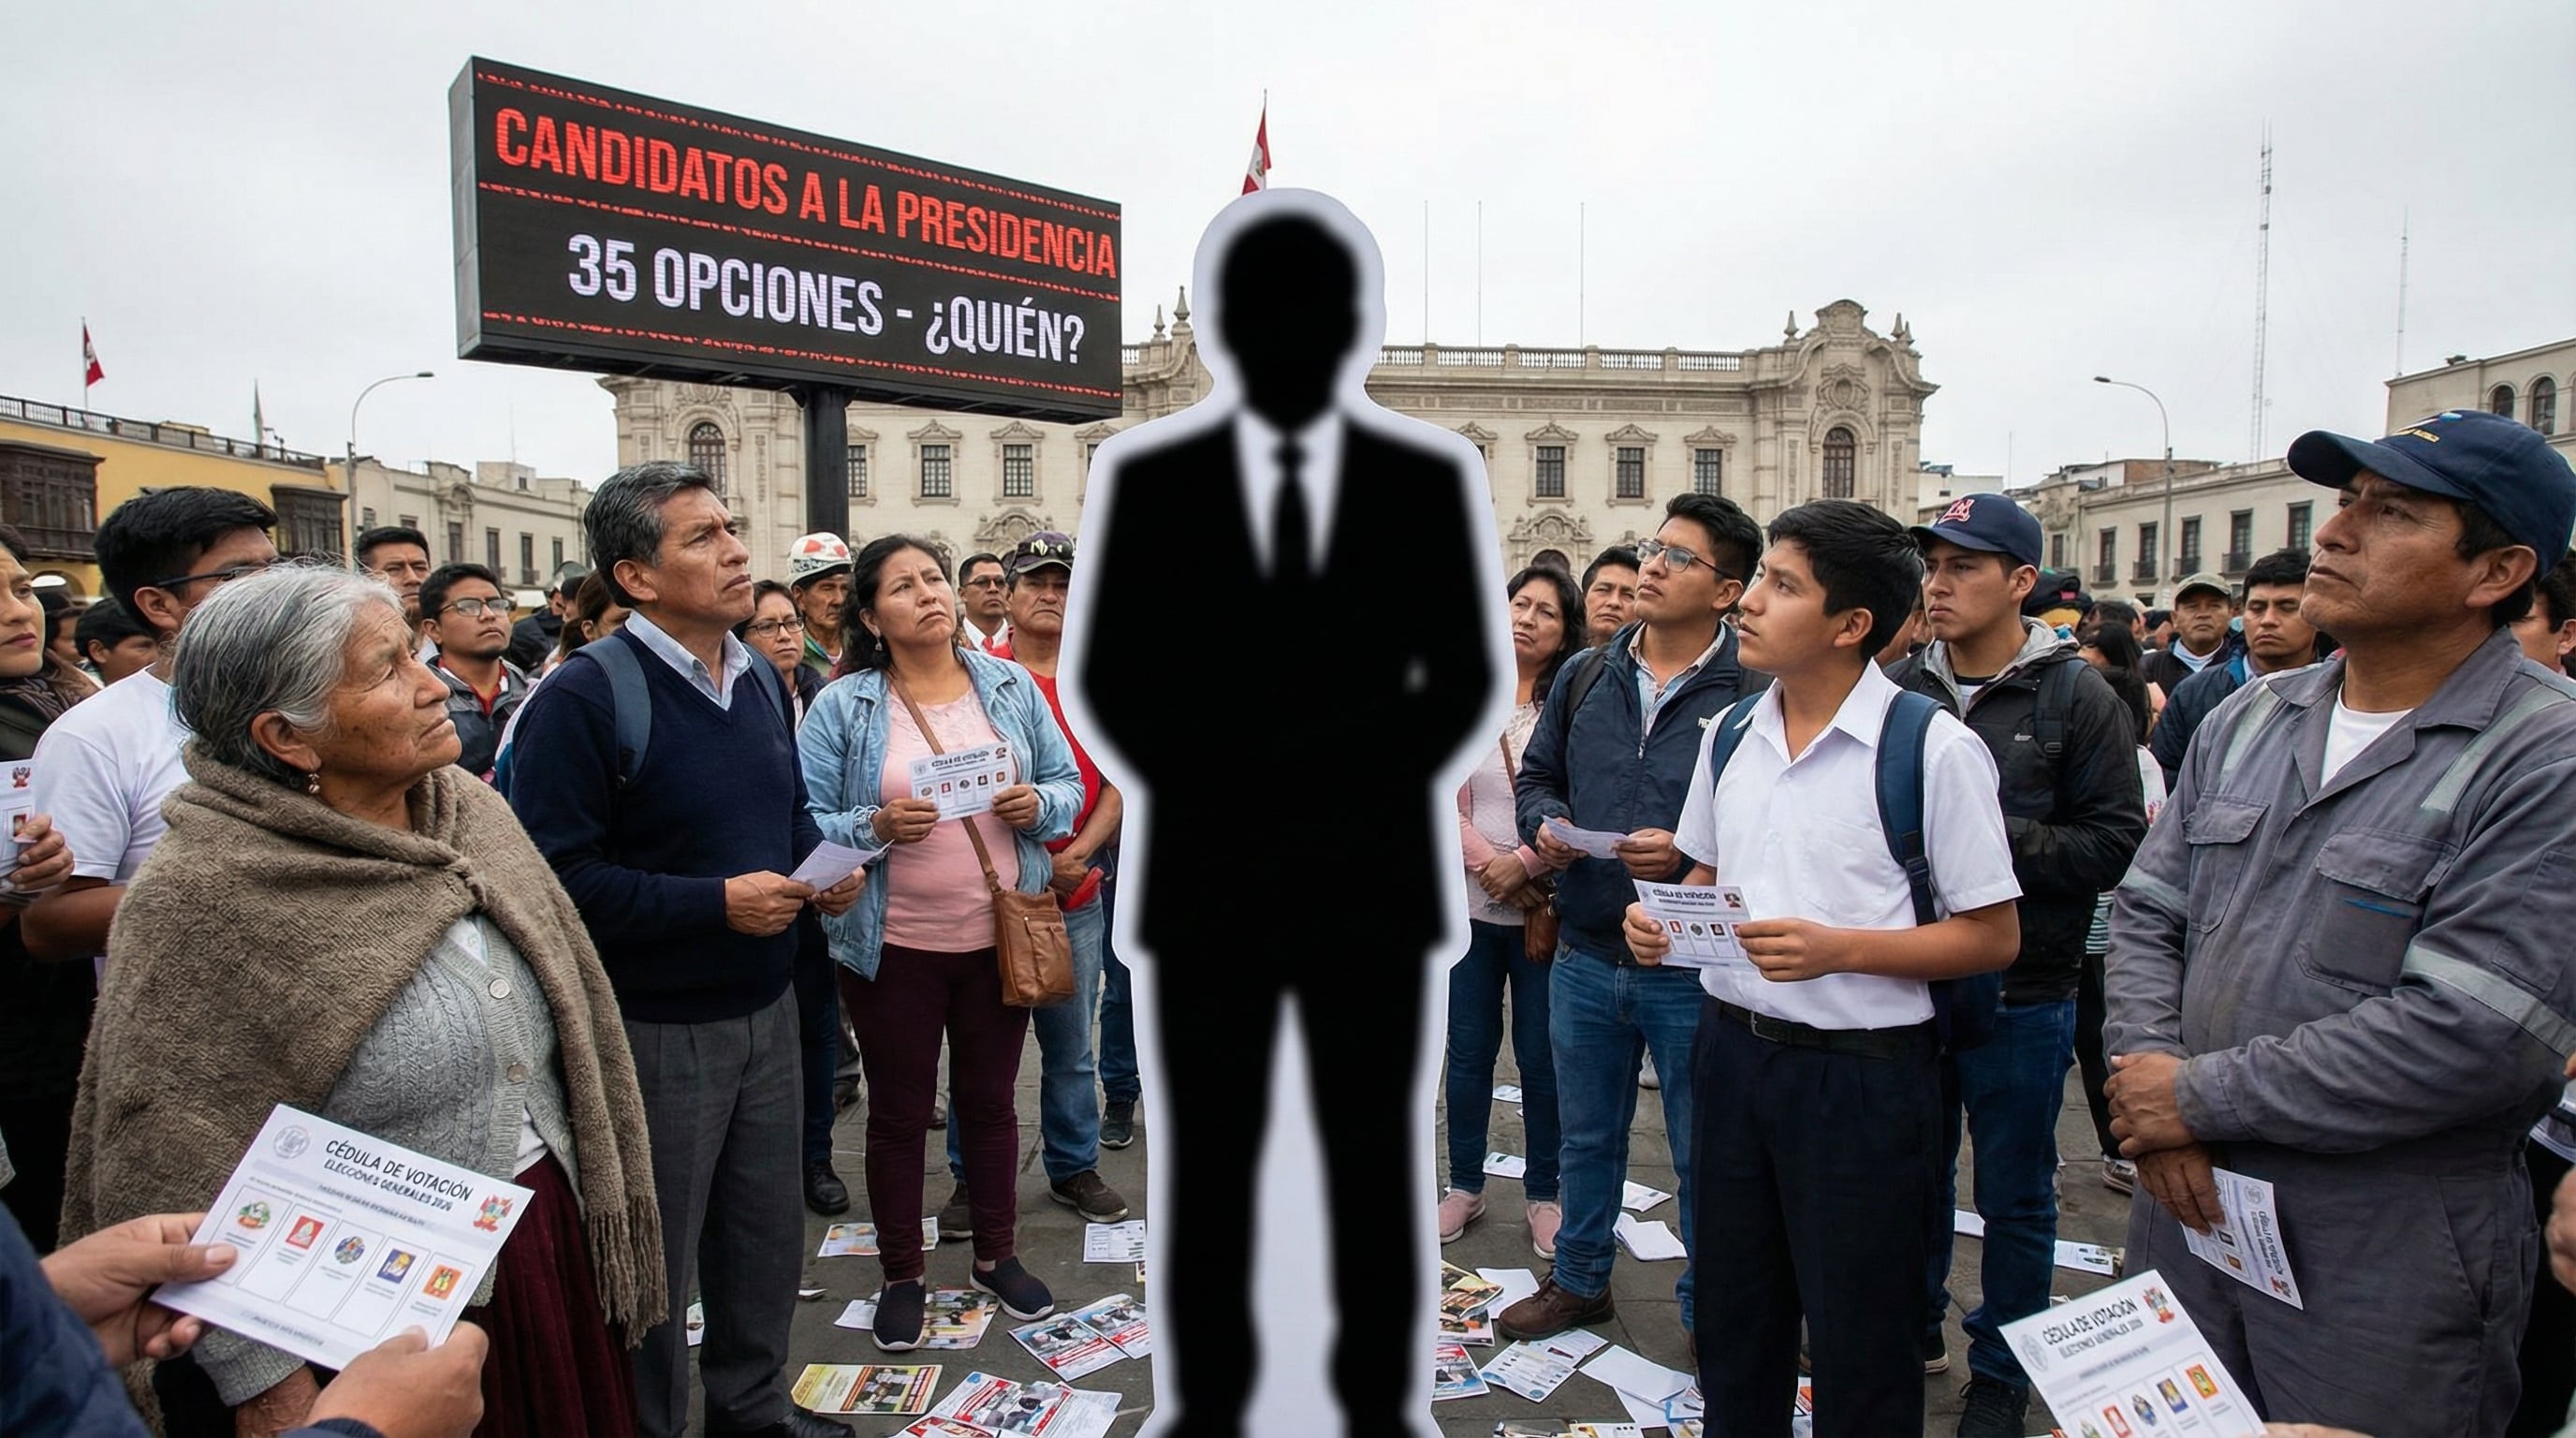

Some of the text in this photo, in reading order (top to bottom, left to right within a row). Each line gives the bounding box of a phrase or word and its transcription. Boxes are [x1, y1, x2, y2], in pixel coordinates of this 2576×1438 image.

[495, 107, 789, 215] CANDIDATOS
[798, 170, 827, 224] A
[838, 176, 886, 235] LA
[896, 190, 1117, 279] PRESIDENCIA
[567, 233, 638, 302] 35
[653, 247, 885, 336] OPCIONES
[896, 308, 914, 319] -
[925, 296, 1086, 364] ¿QUIÉN?
[325, 1139, 475, 1202] CÉDULA DE VOTACIÓN
